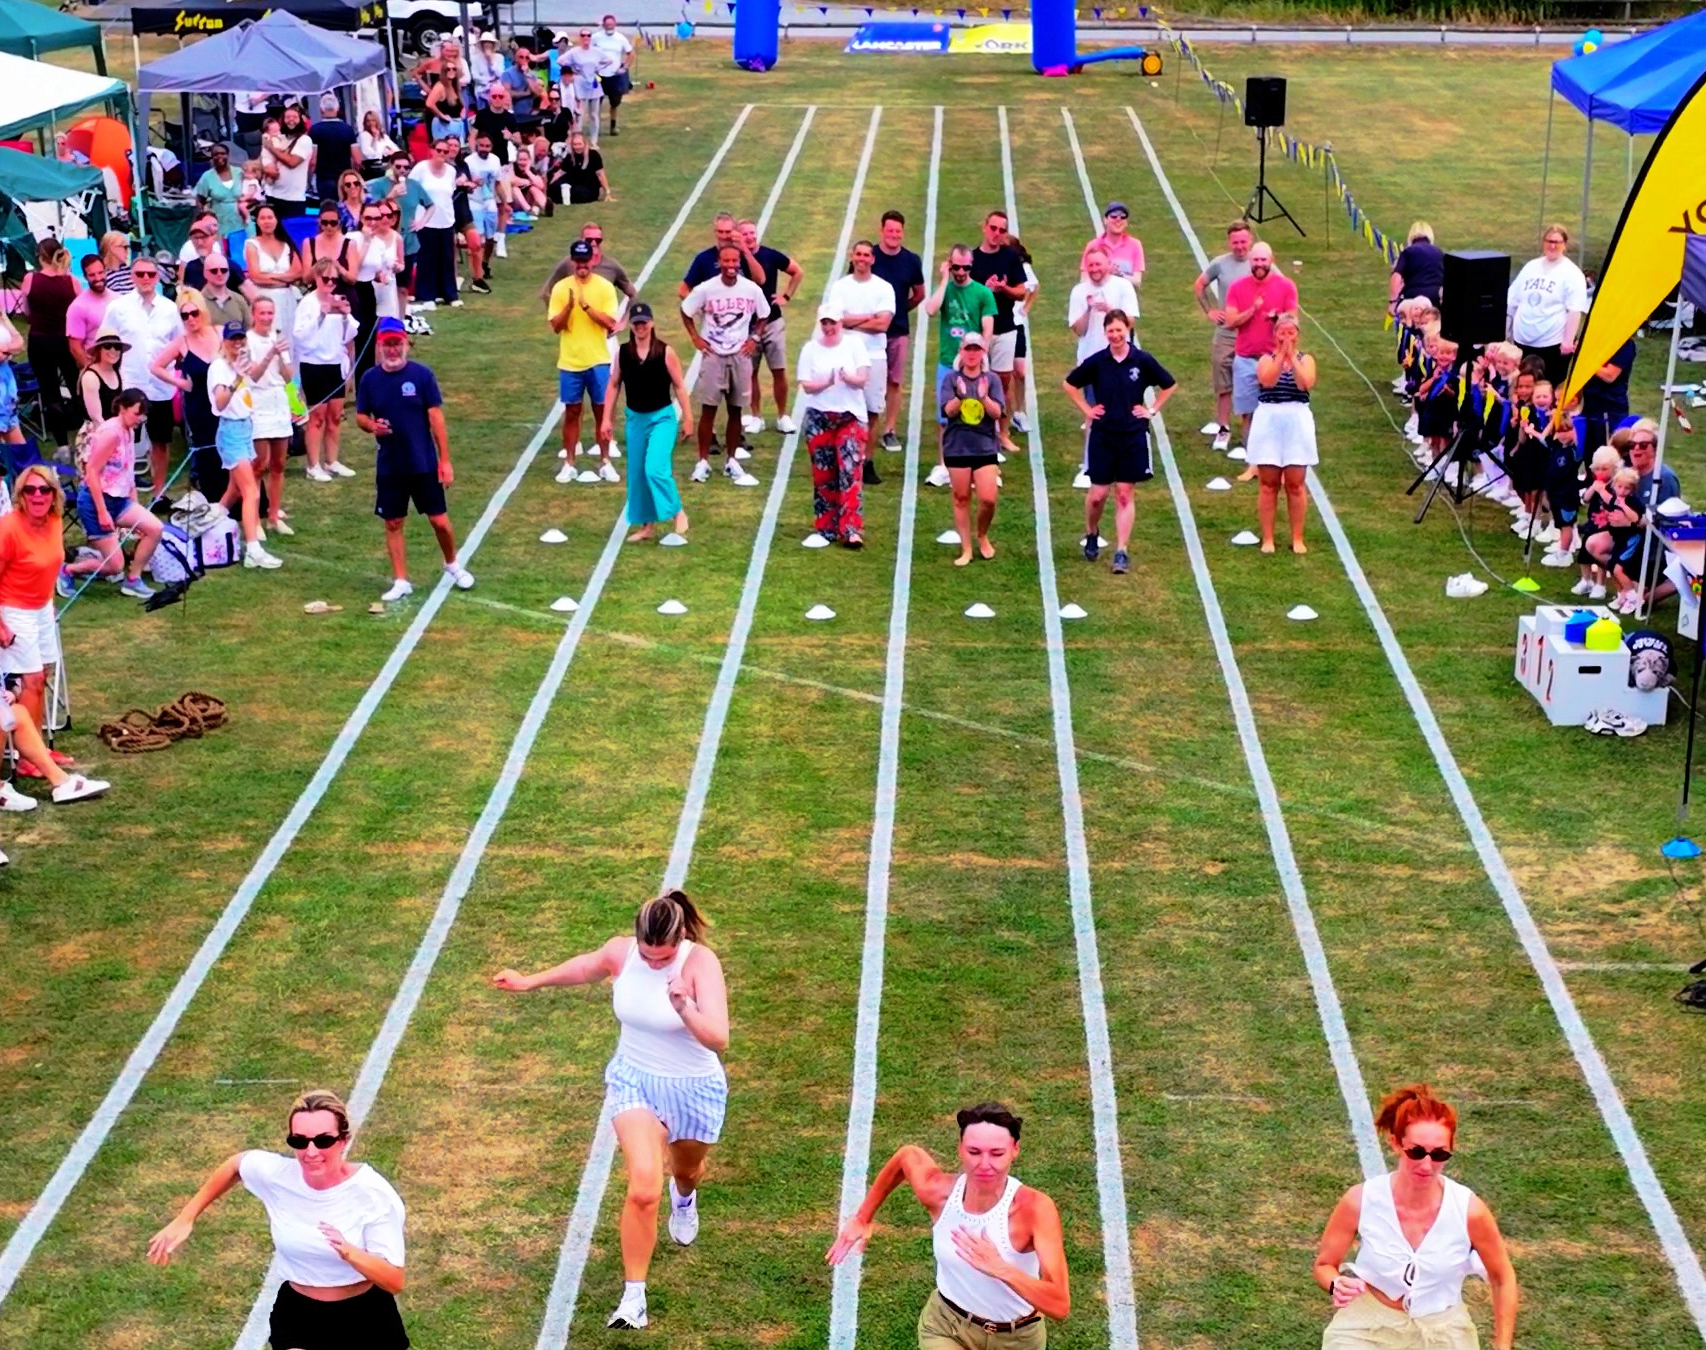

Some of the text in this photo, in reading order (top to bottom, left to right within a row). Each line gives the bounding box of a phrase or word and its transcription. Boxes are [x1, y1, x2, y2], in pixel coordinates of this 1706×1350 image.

[1524, 278, 1555, 293] YALE
[706, 297, 756, 315] ALLEN
[1536, 634, 1545, 685] 1
[1545, 657, 1555, 703] 2
